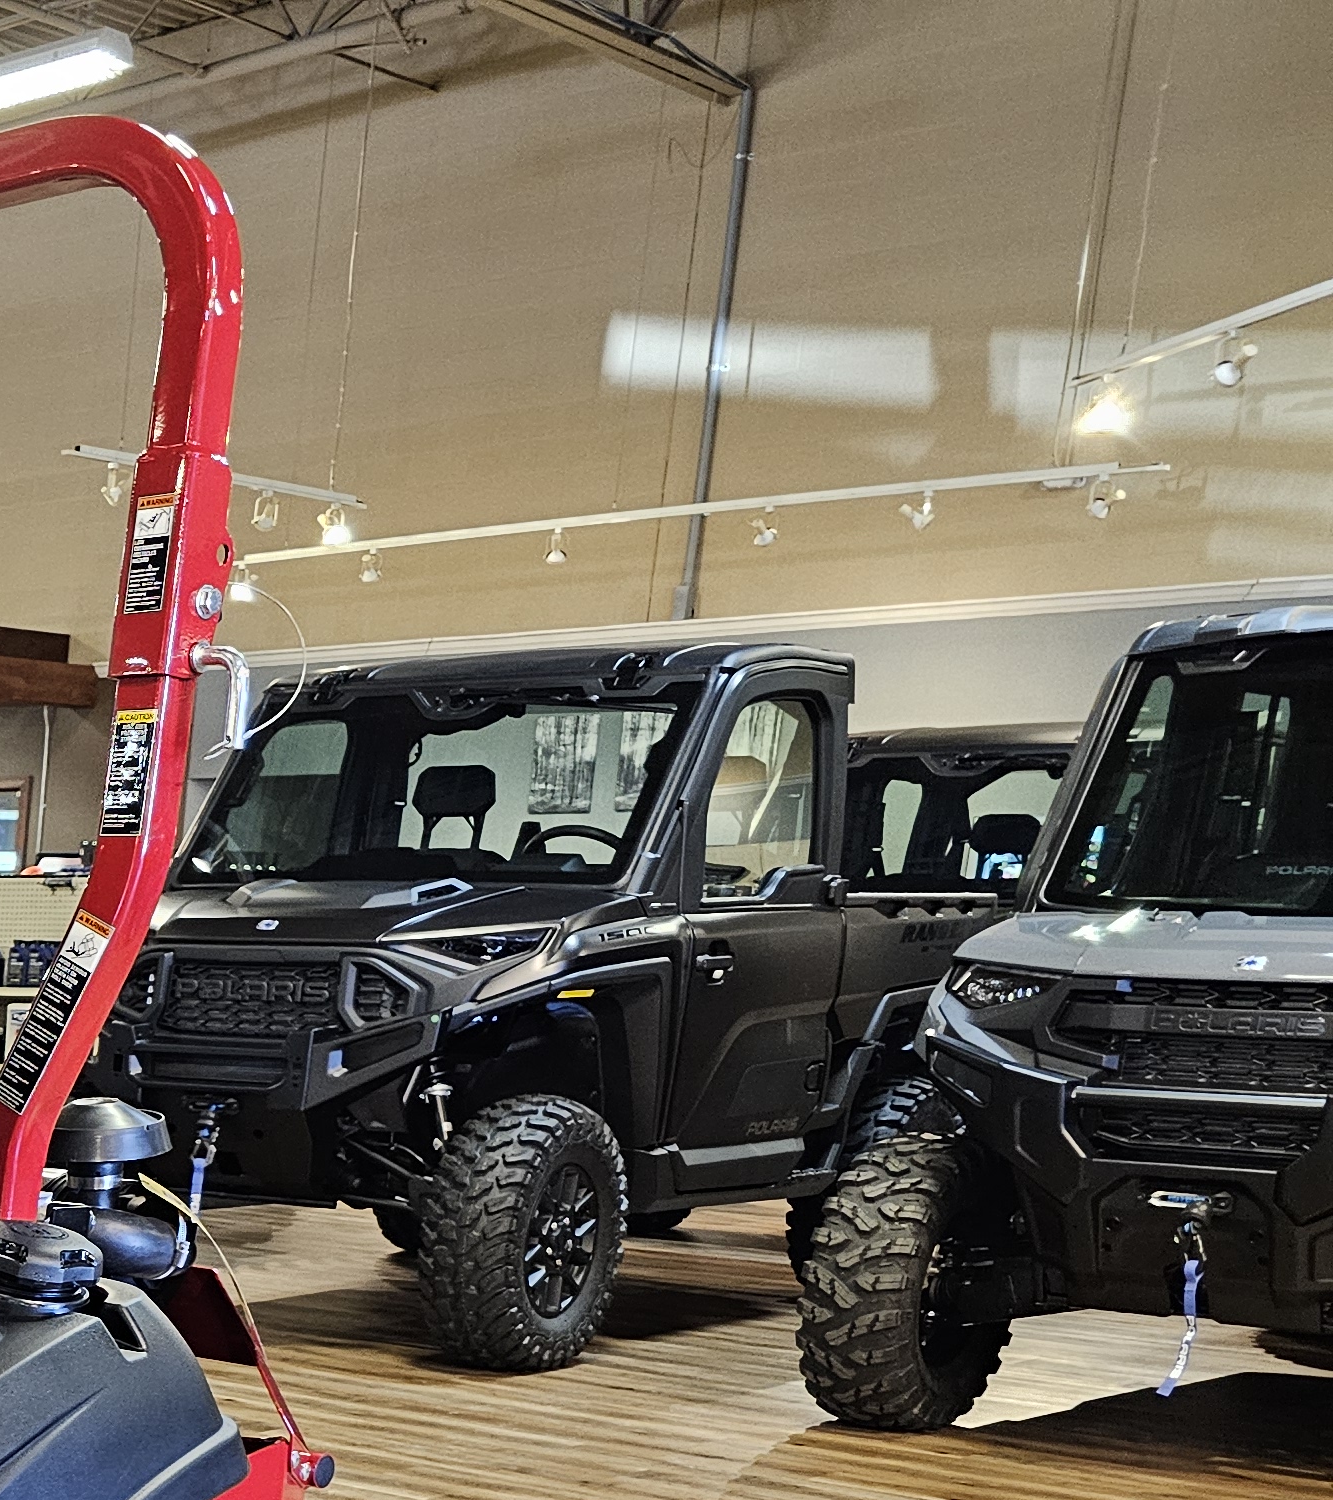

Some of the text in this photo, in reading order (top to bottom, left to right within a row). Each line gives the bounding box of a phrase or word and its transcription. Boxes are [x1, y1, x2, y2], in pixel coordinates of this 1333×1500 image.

[123, 712, 155, 722] CAUTION
[84, 915, 110, 936] WARNING
[176, 976, 330, 1002] POLARIS
[1150, 1011, 1326, 1037] POLARIS
[745, 1116, 800, 1137] POLARIS
[1169, 1315, 1196, 1379] POLARIS
